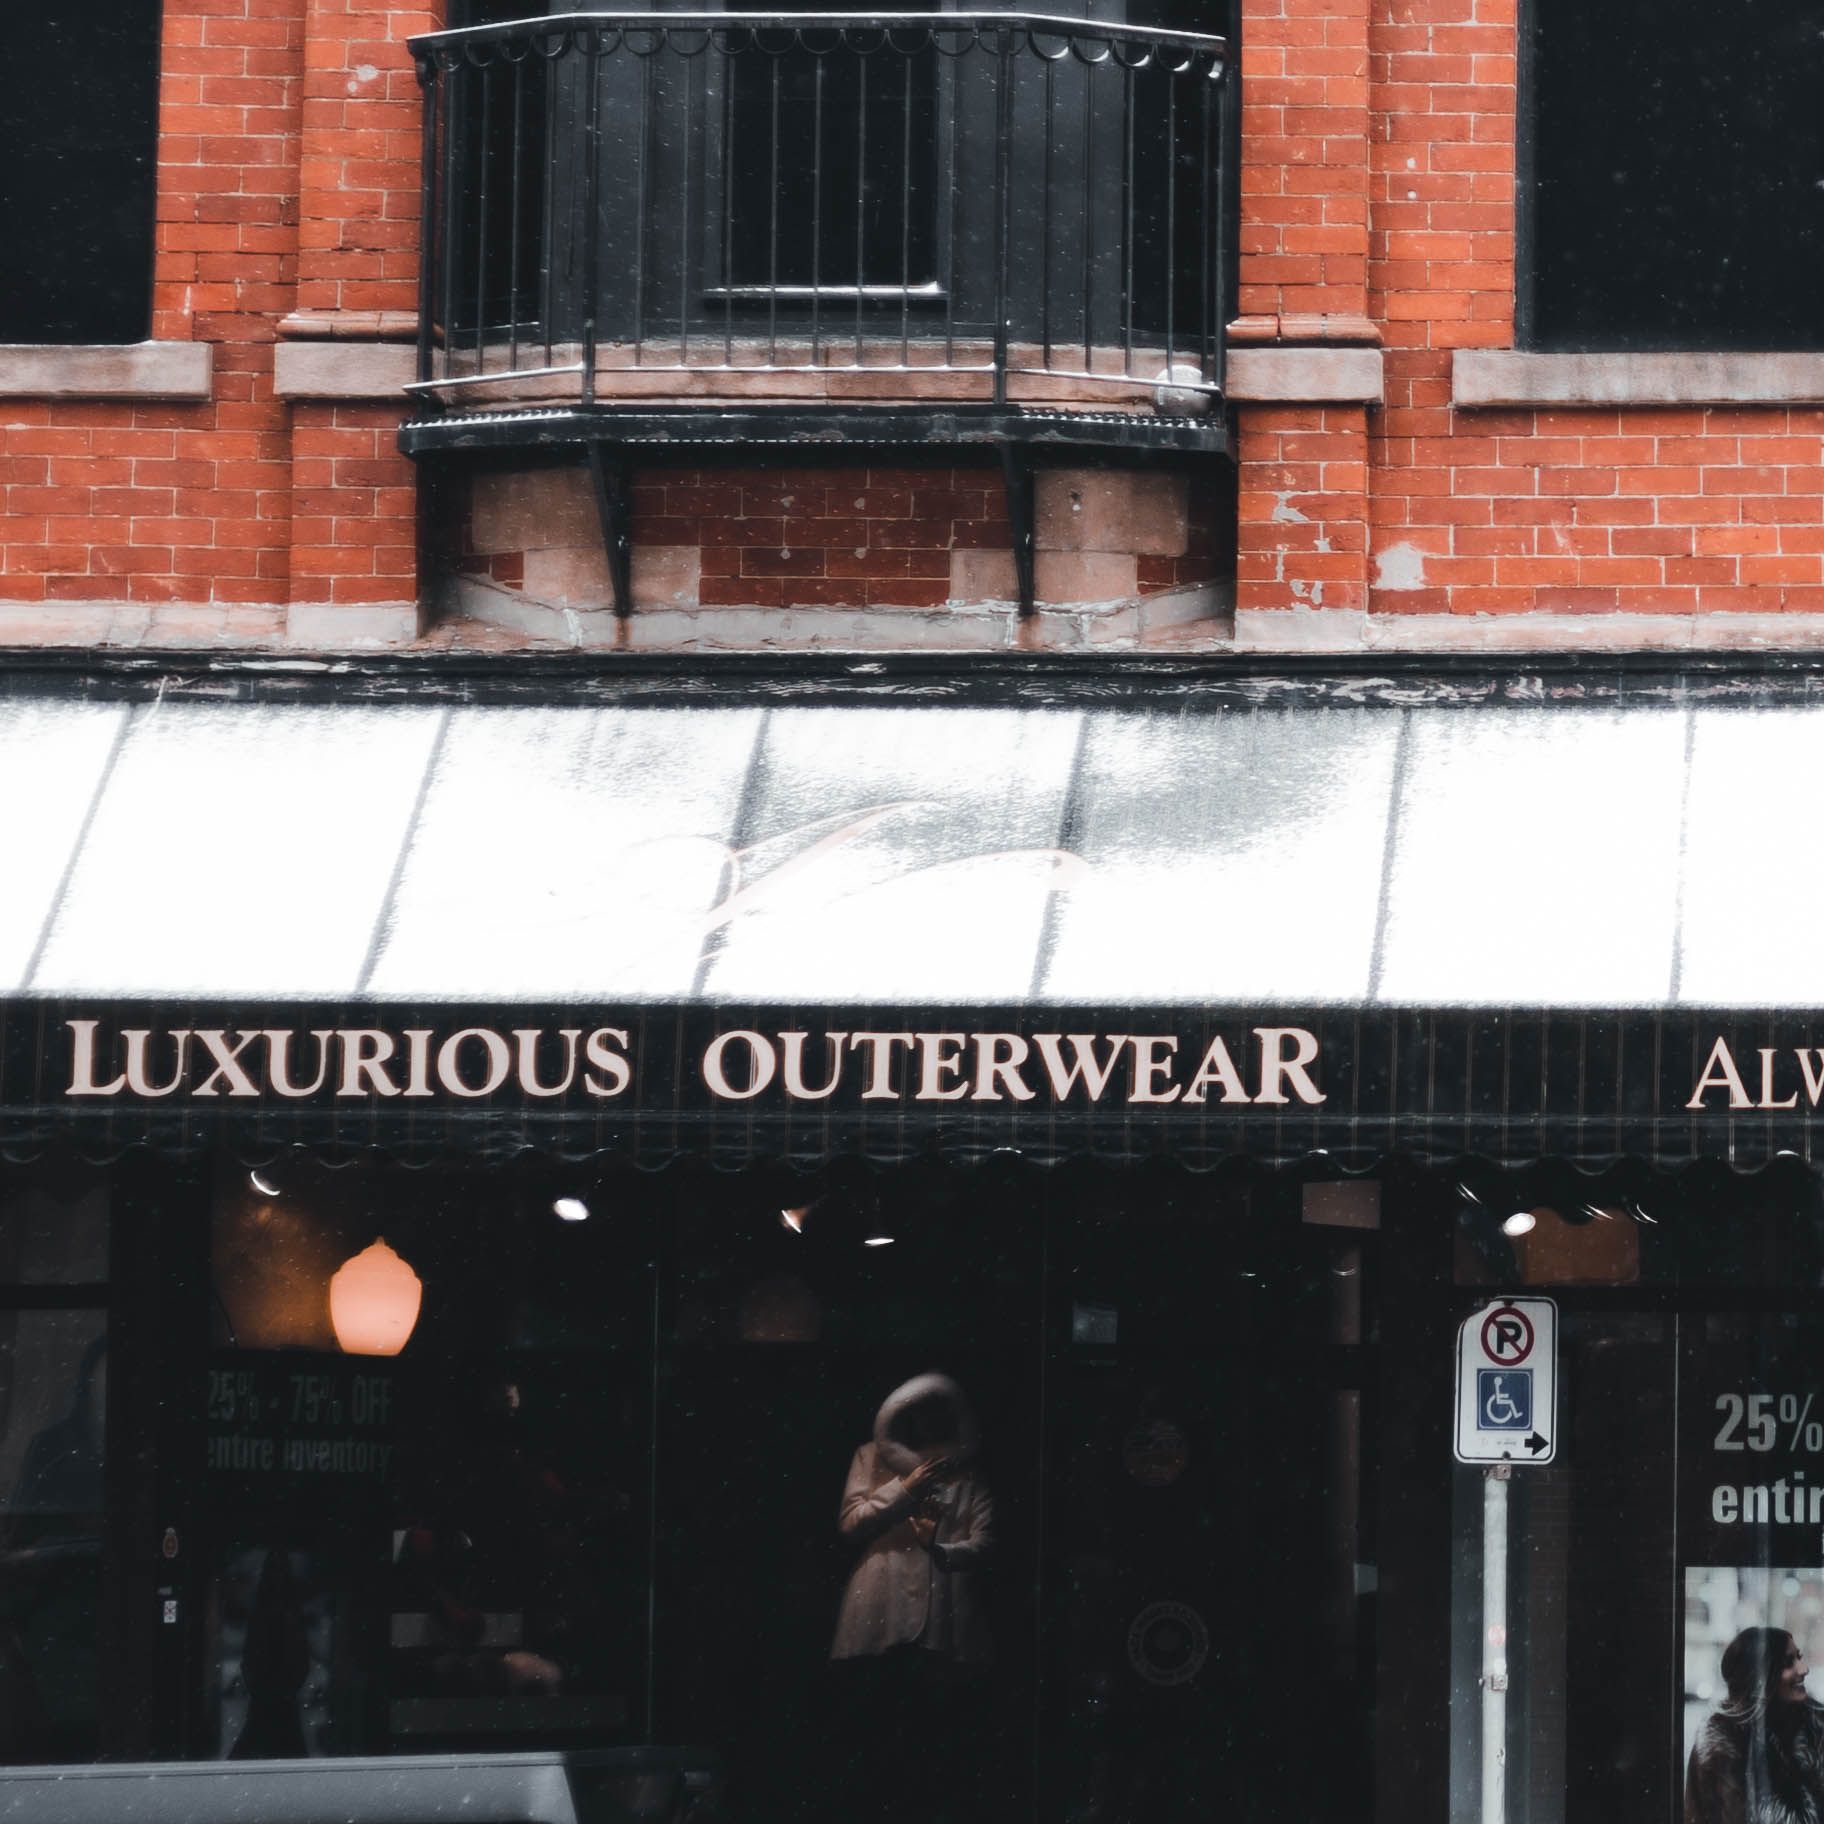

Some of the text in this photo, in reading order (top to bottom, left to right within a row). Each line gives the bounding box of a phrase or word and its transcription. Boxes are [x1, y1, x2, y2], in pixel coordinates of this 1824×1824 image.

[65, 1019, 1327, 1105] LUXURIOUS OUTERWEAR
[351, 1374, 393, 1425] OFF
[1713, 1393, 1823, 1453] 25%
